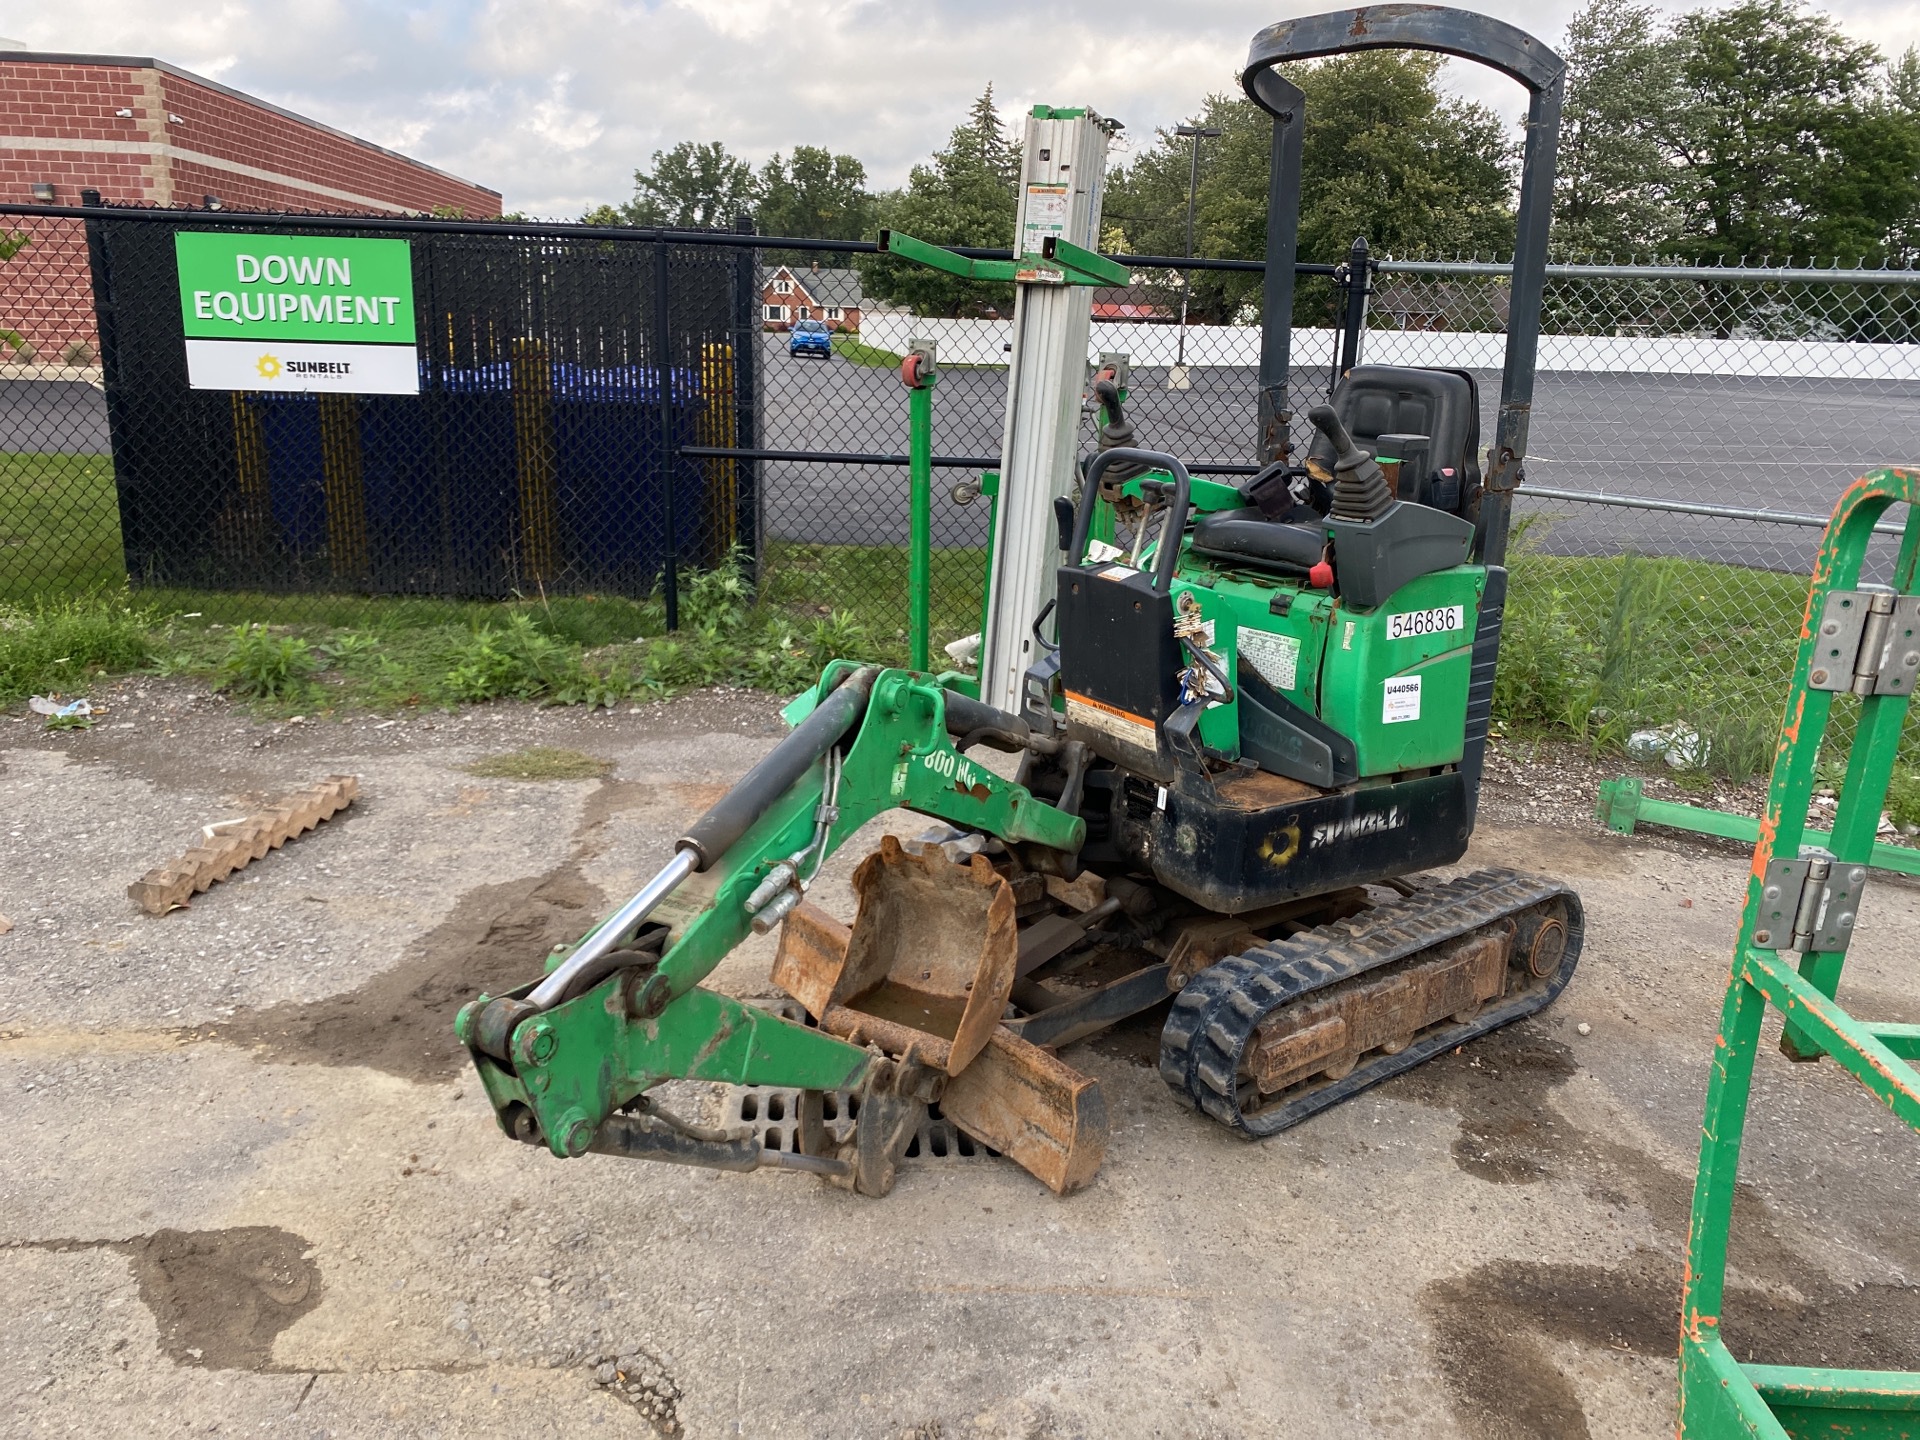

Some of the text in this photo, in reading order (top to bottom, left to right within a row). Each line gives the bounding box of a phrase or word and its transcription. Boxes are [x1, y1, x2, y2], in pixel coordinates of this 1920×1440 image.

[236, 254, 351, 286] DOWN
[194, 290, 400, 325] EQUIPMENT
[286, 361, 351, 374] SUNBELT
[1392, 607, 1455, 638] 546836
[1387, 683, 1419, 695] U440566
[1097, 703, 1126, 718] WARNING
